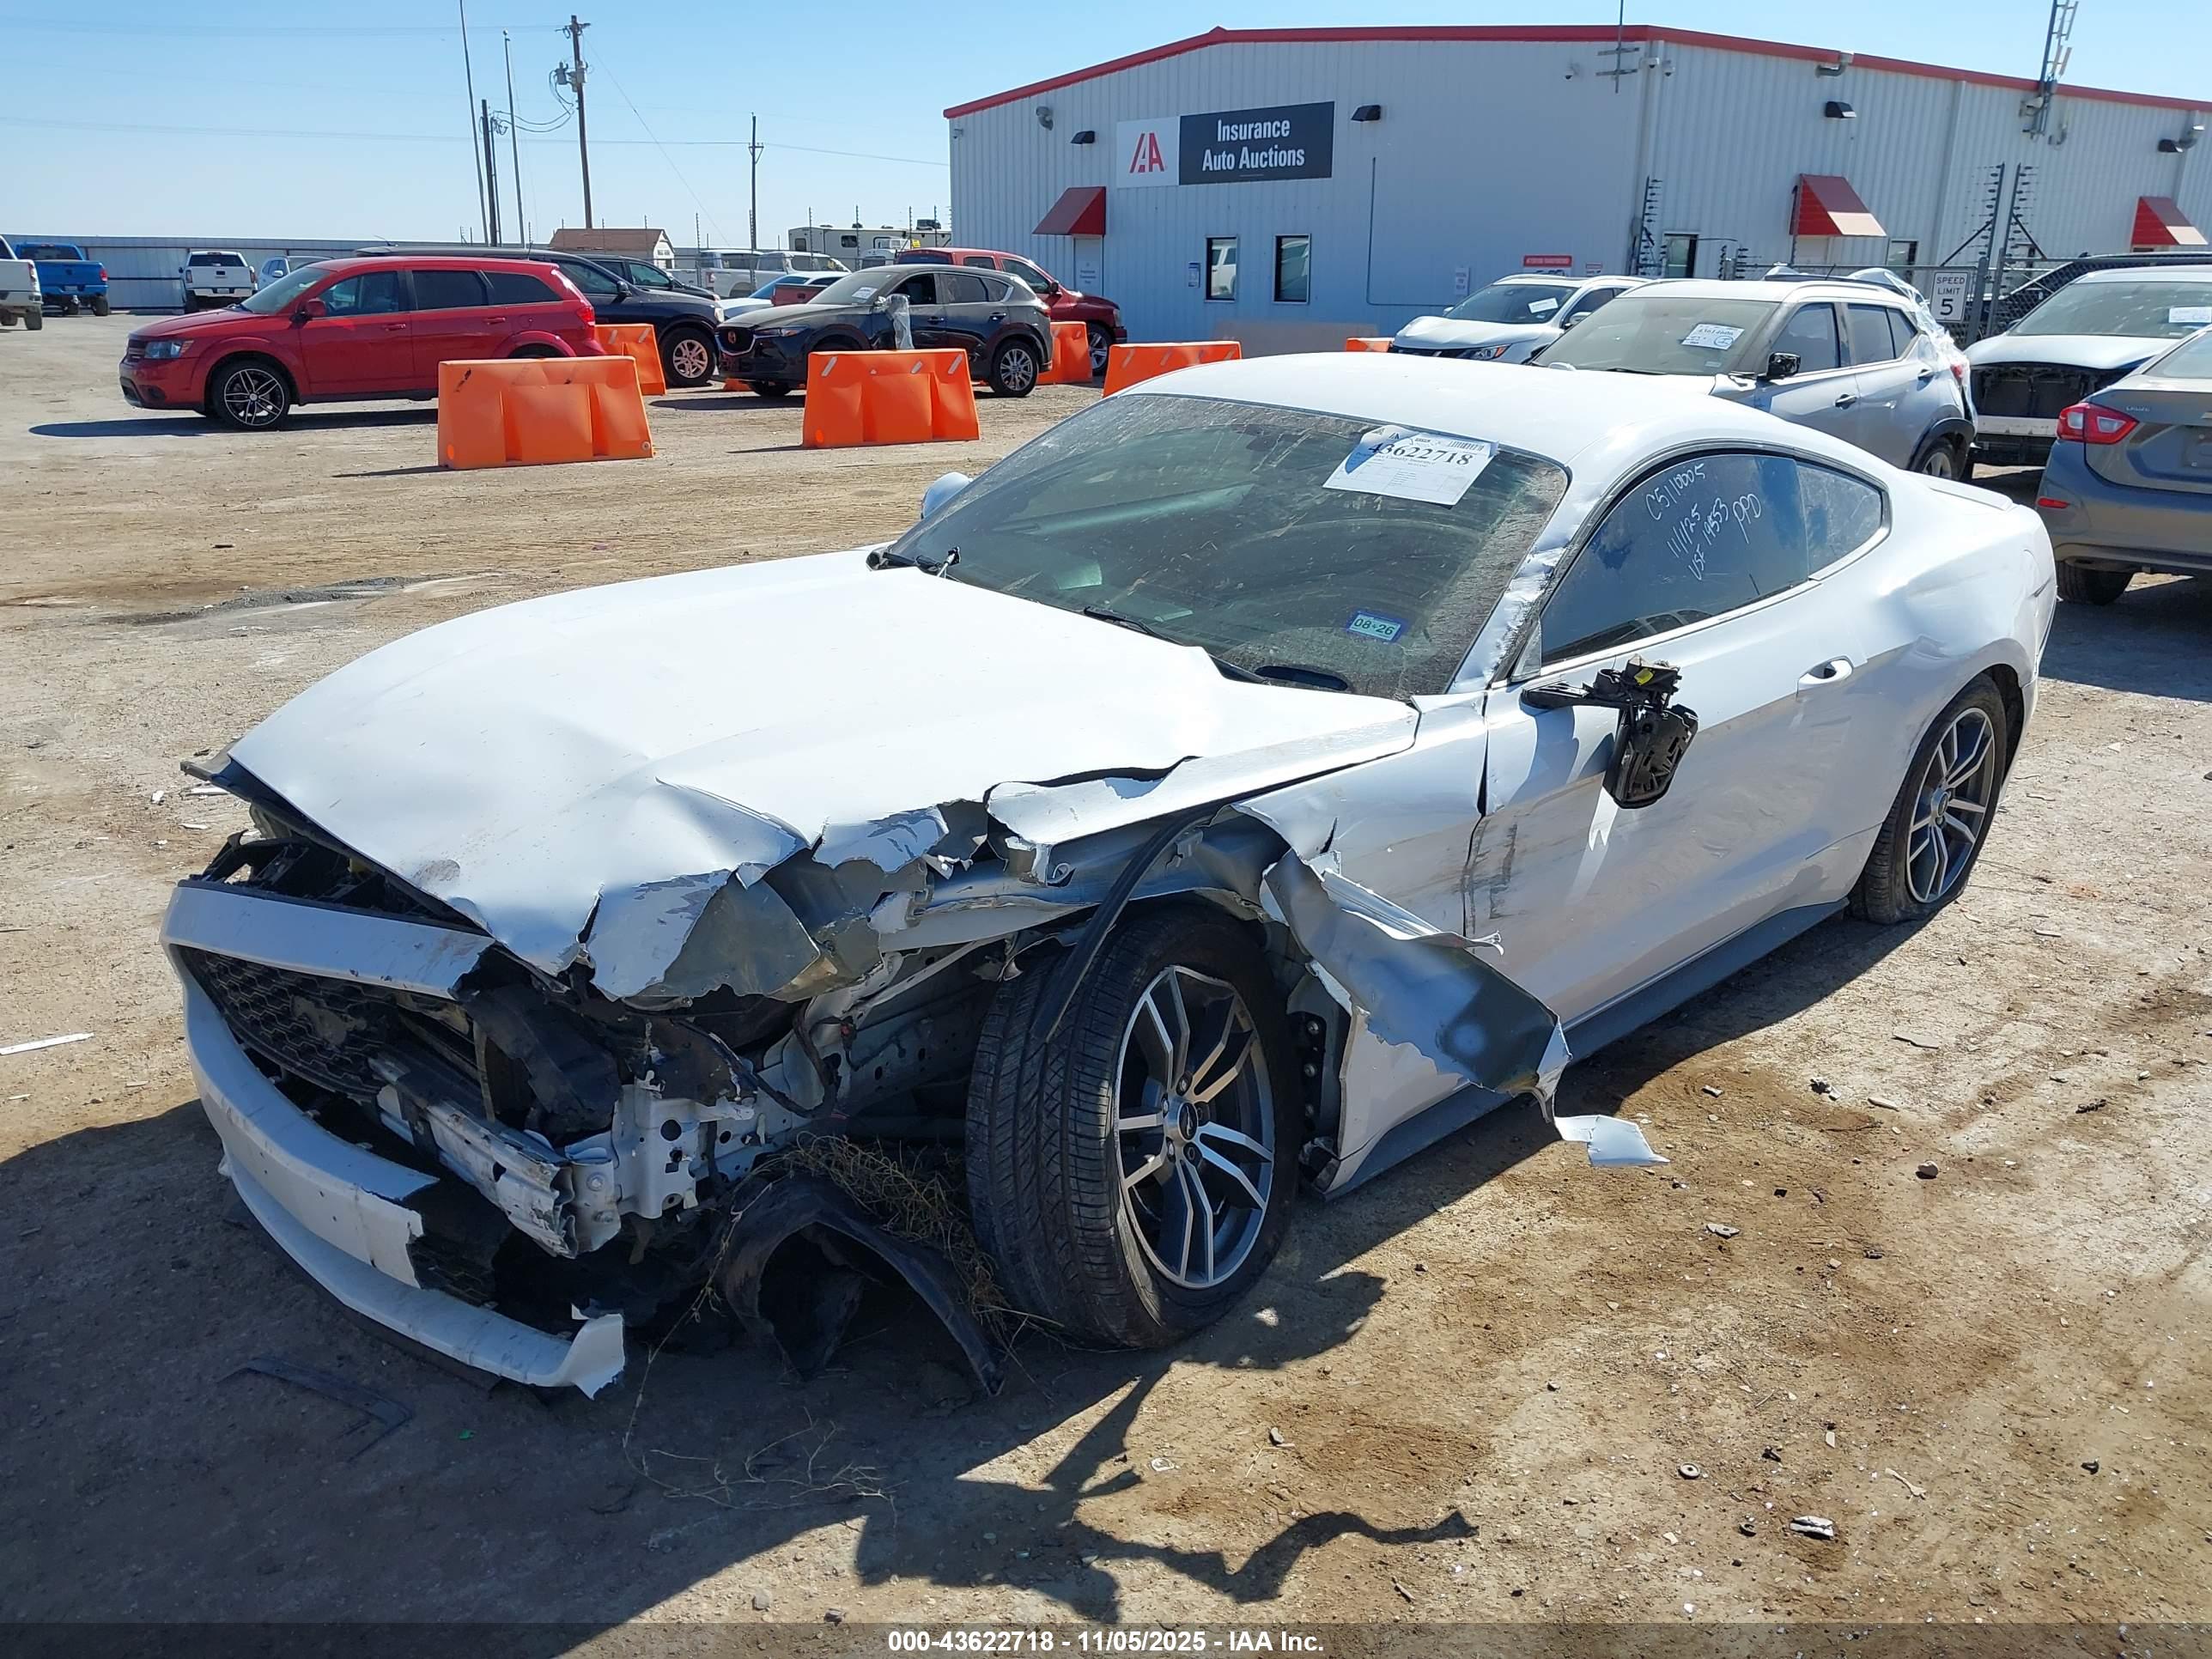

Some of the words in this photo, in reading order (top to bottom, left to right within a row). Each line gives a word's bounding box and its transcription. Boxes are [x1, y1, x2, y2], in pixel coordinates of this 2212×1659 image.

[1217, 118, 1290, 142] Insurance
[1202, 149, 1235, 172] Auto
[1239, 144, 1305, 169] Auctions
[1940, 298, 1954, 316] 5
[1368, 442, 1473, 465] 43622718
